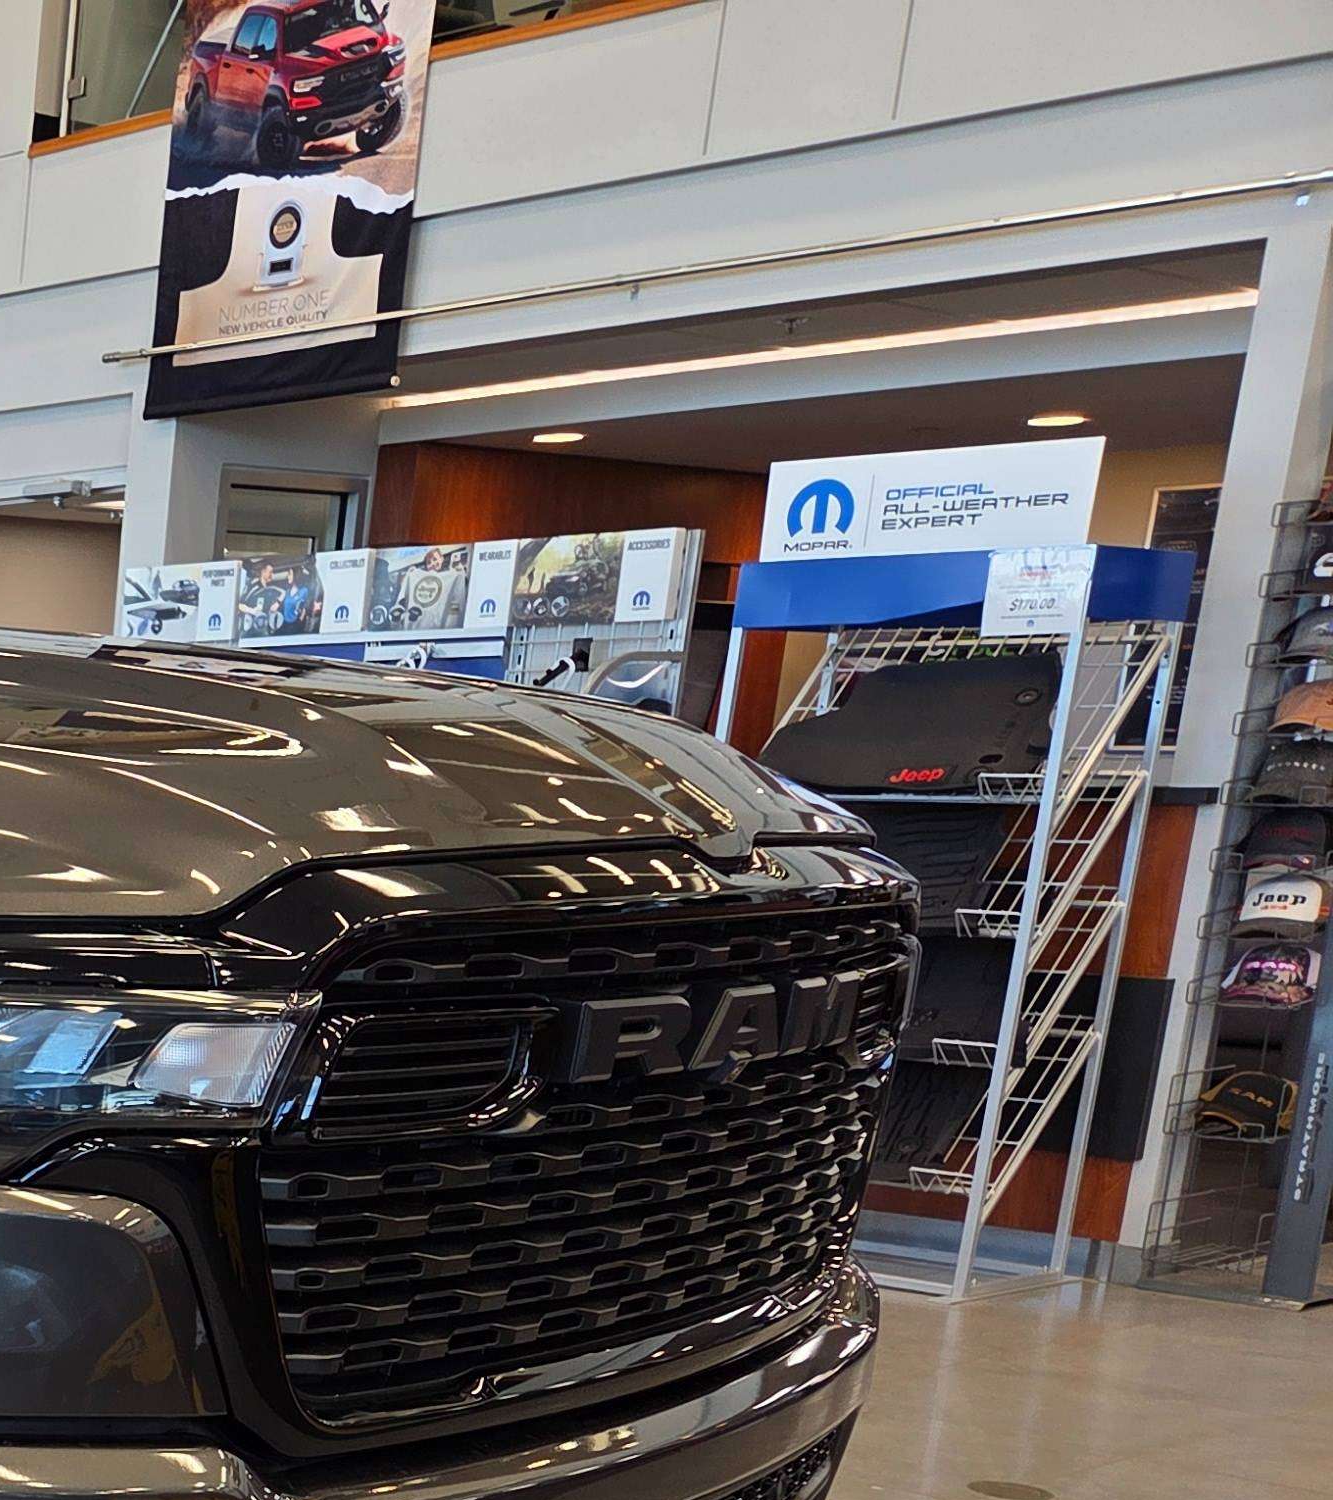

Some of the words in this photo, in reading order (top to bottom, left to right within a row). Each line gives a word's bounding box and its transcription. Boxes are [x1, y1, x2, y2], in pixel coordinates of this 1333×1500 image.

[219, 298, 289, 323] NUMBER
[293, 289, 330, 312] ONE
[218, 323, 240, 336] NEW
[243, 316, 284, 333] VEHICLE
[286, 310, 329, 326] QUALITY
[885, 483, 995, 501] OFFICIAL
[882, 493, 1070, 517] ALL-WEATHER
[880, 513, 984, 531] EXPERT
[889, 767, 946, 783] Jeep
[1252, 892, 1308, 907] Jeep
[569, 970, 861, 1084] RAM
